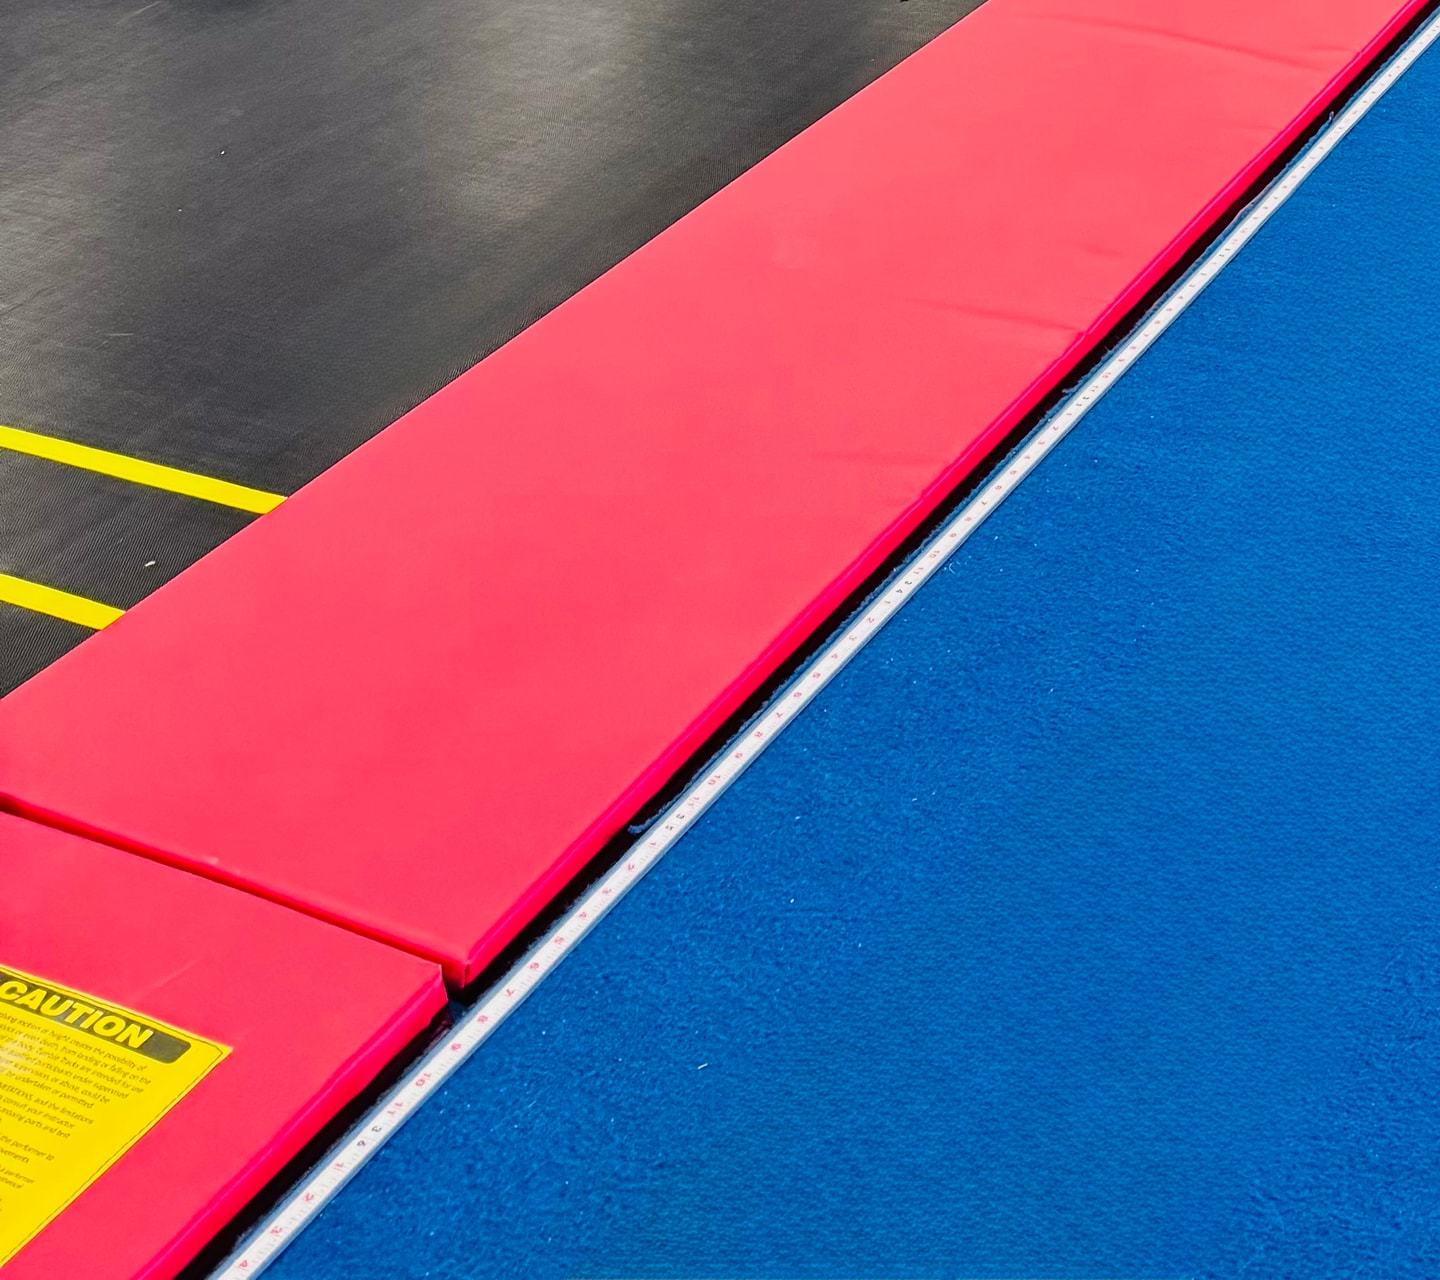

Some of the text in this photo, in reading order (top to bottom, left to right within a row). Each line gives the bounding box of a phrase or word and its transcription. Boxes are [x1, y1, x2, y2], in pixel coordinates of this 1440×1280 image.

[0, 981, 154, 1049] CAUTION
[45, 1030, 71, 1043] height
[105, 1063, 132, 1078] falling
[79, 1088, 103, 1099] could
[304, 1192, 314, 1202] 2
